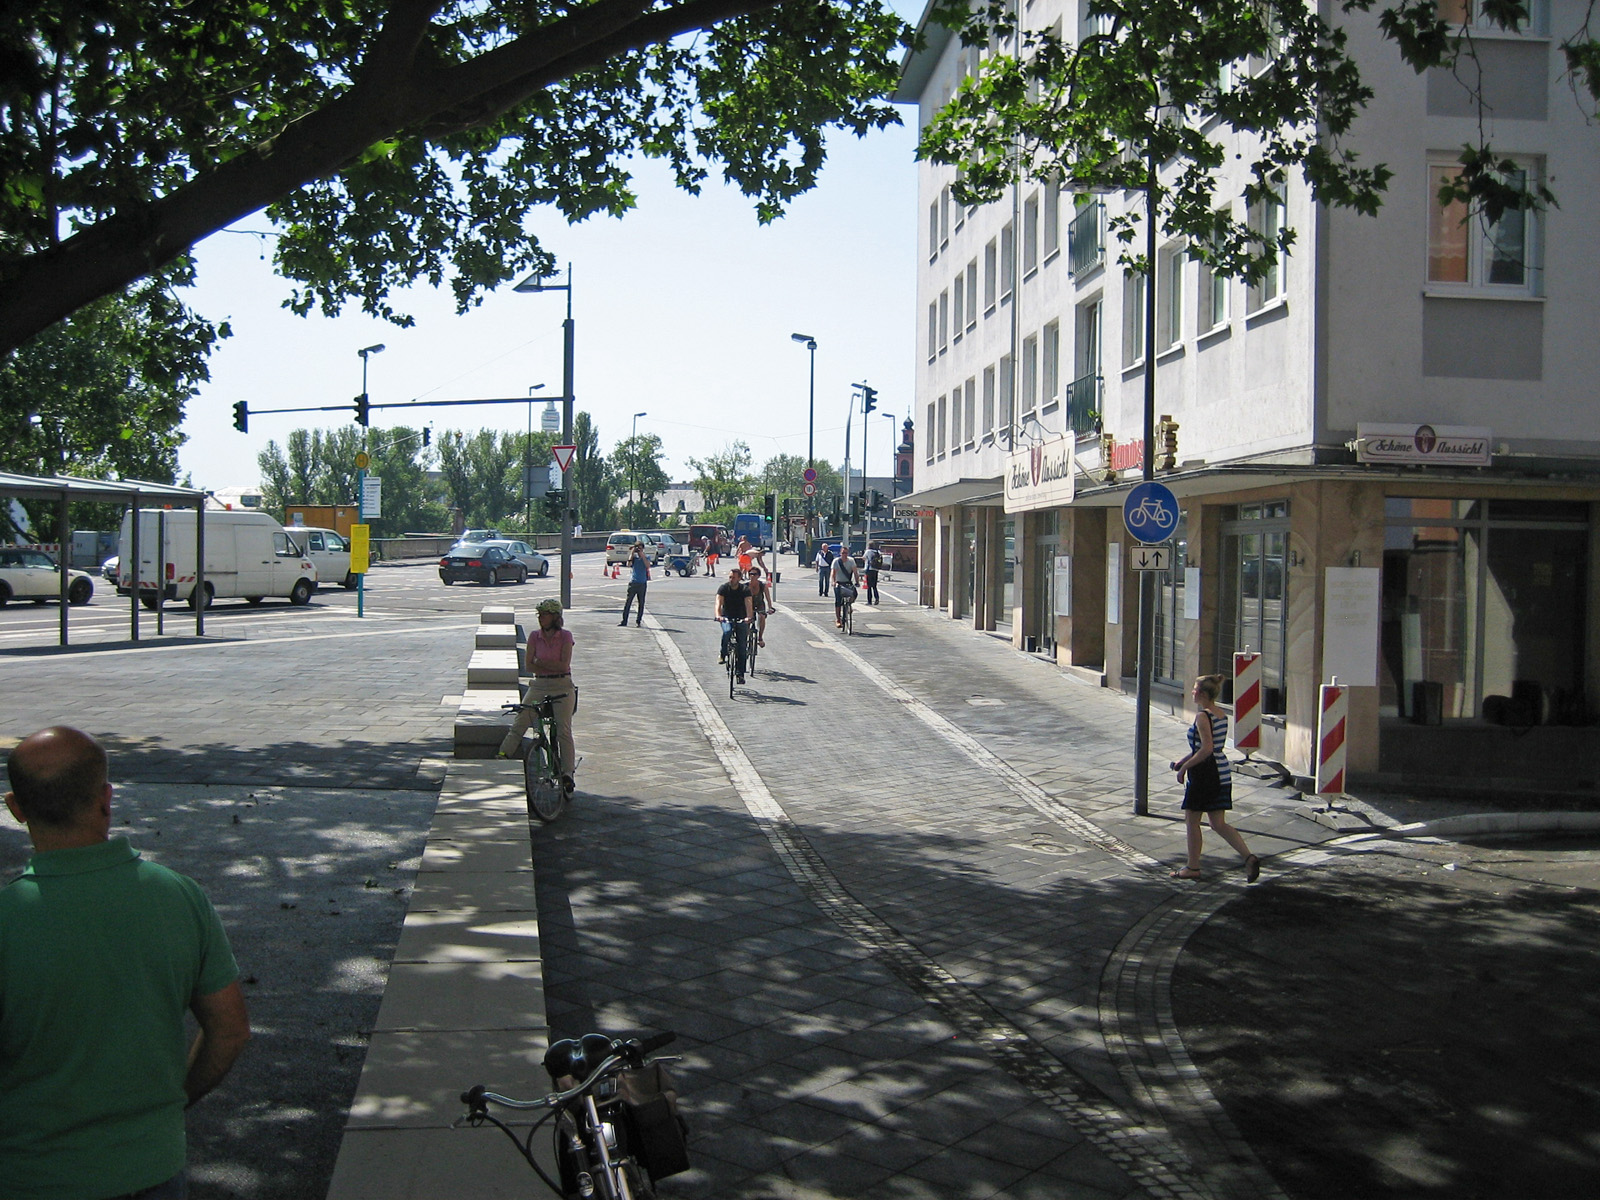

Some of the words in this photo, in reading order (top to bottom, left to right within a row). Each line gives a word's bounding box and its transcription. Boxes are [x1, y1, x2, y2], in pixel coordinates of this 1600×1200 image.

[1376, 439, 1412, 452] Schöne
[1436, 441, 1483, 454] Aussicht
[1041, 448, 1070, 483] Aussicht
